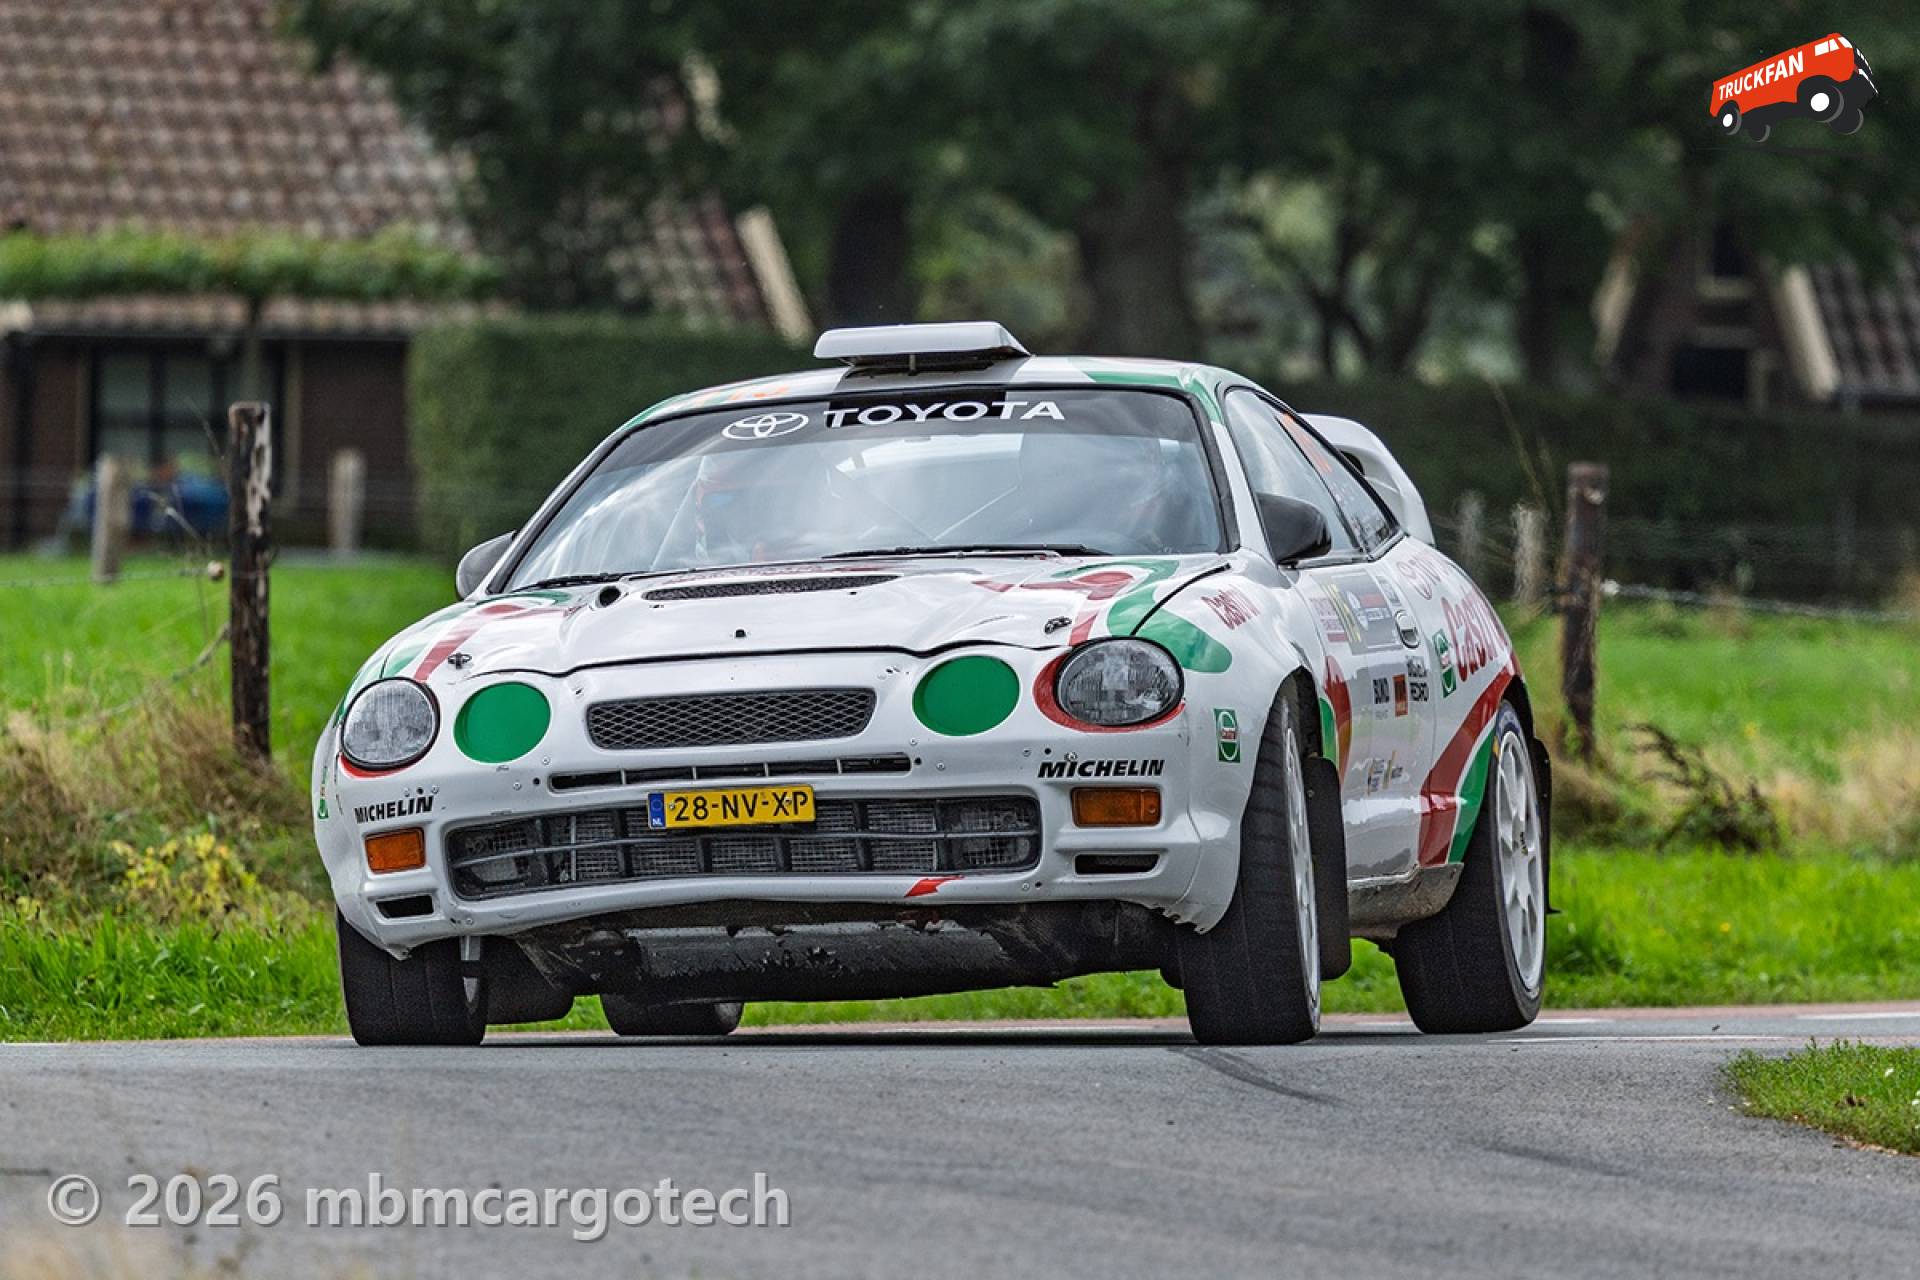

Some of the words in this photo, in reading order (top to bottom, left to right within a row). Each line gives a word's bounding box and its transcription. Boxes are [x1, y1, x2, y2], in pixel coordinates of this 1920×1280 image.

[824, 401, 1065, 428] TOYOTA
[1037, 760, 1165, 778] MICHELIN
[355, 796, 434, 823] MICHELIN
[674, 791, 808, 821] 28-NV-XP
[652, 818, 664, 826] NL
